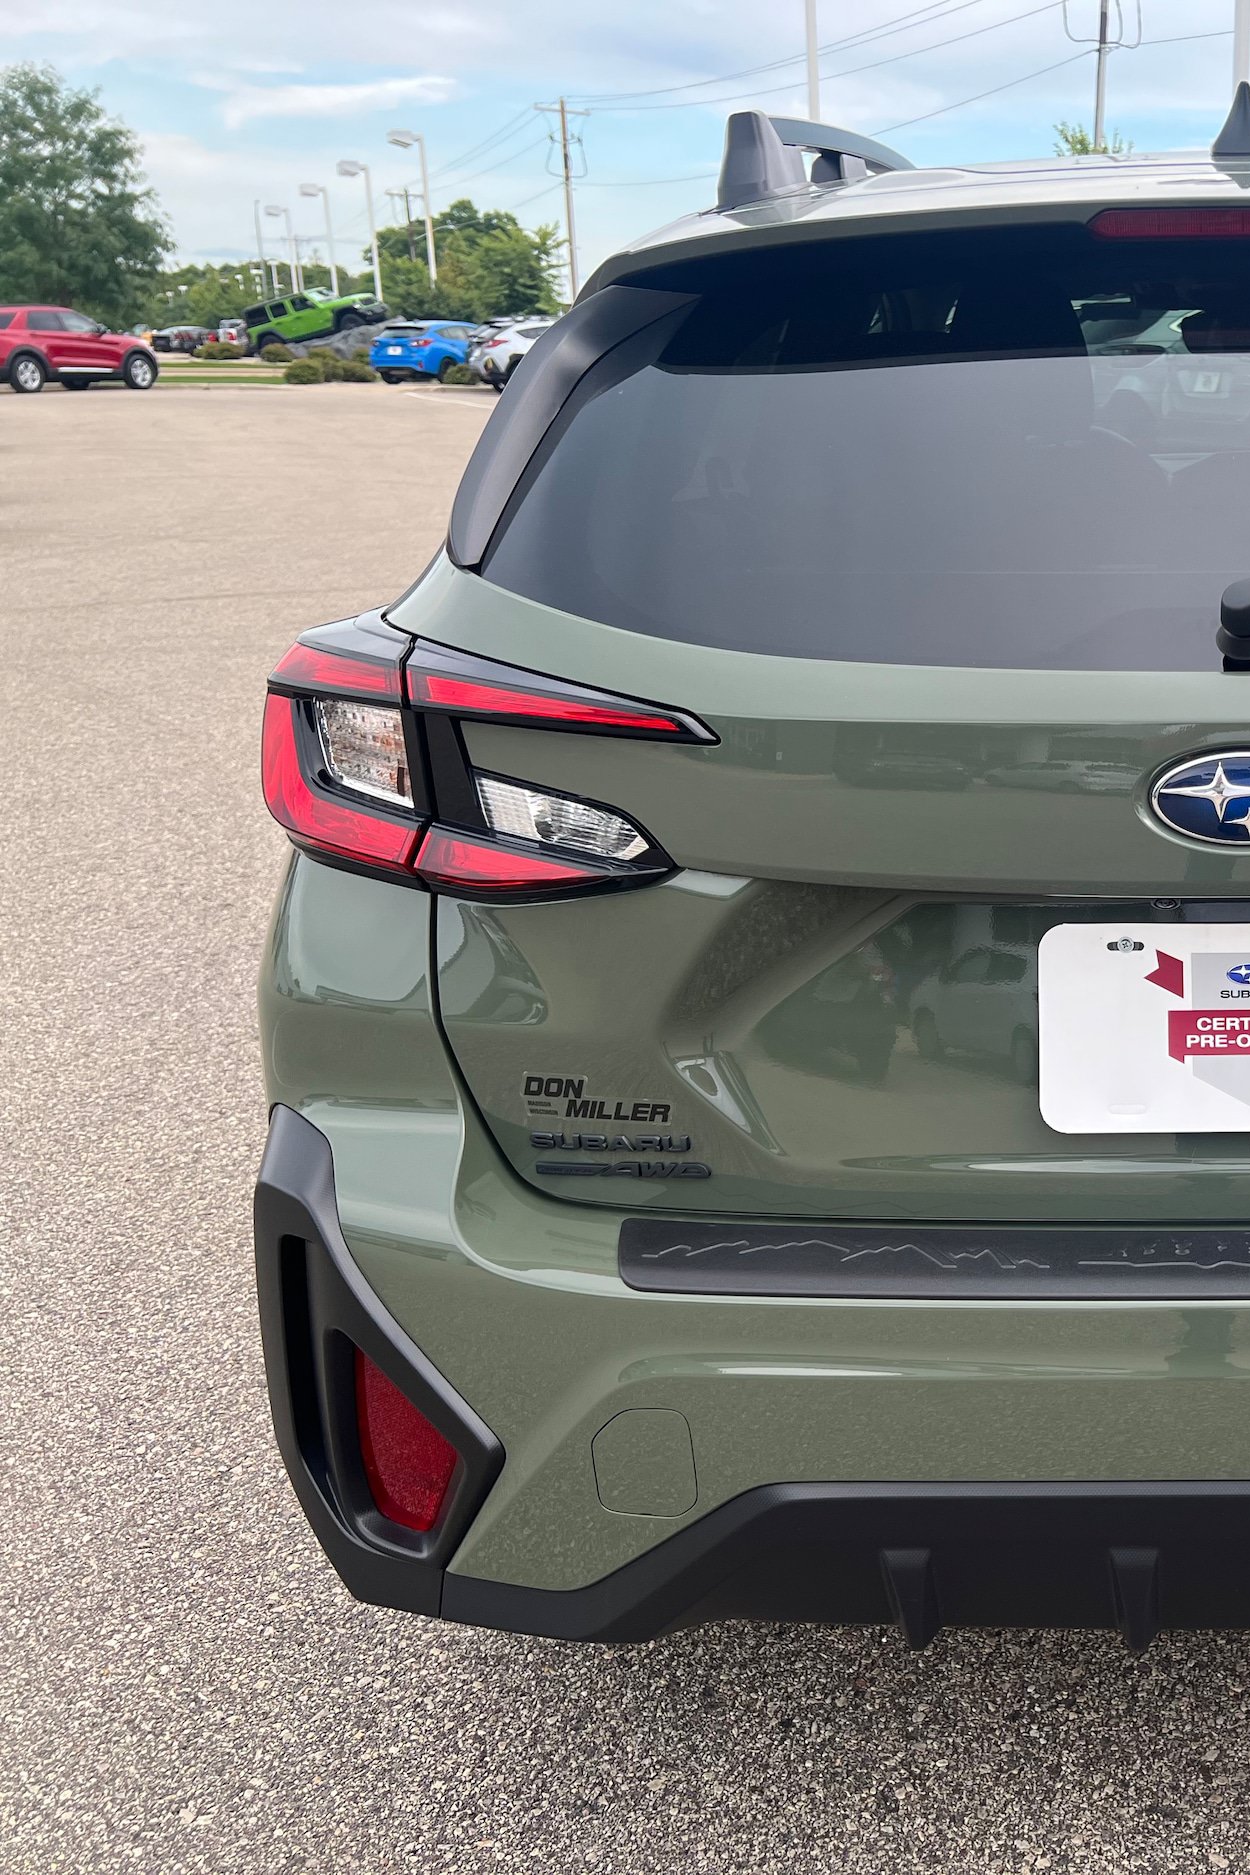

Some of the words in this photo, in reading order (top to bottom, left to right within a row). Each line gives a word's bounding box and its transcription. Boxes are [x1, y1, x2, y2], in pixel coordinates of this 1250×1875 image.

[524, 1076, 584, 1098] DON
[565, 1099, 671, 1122] MILLER
[529, 1131, 692, 1153] SUBARU
[599, 1161, 713, 1179] AWD
